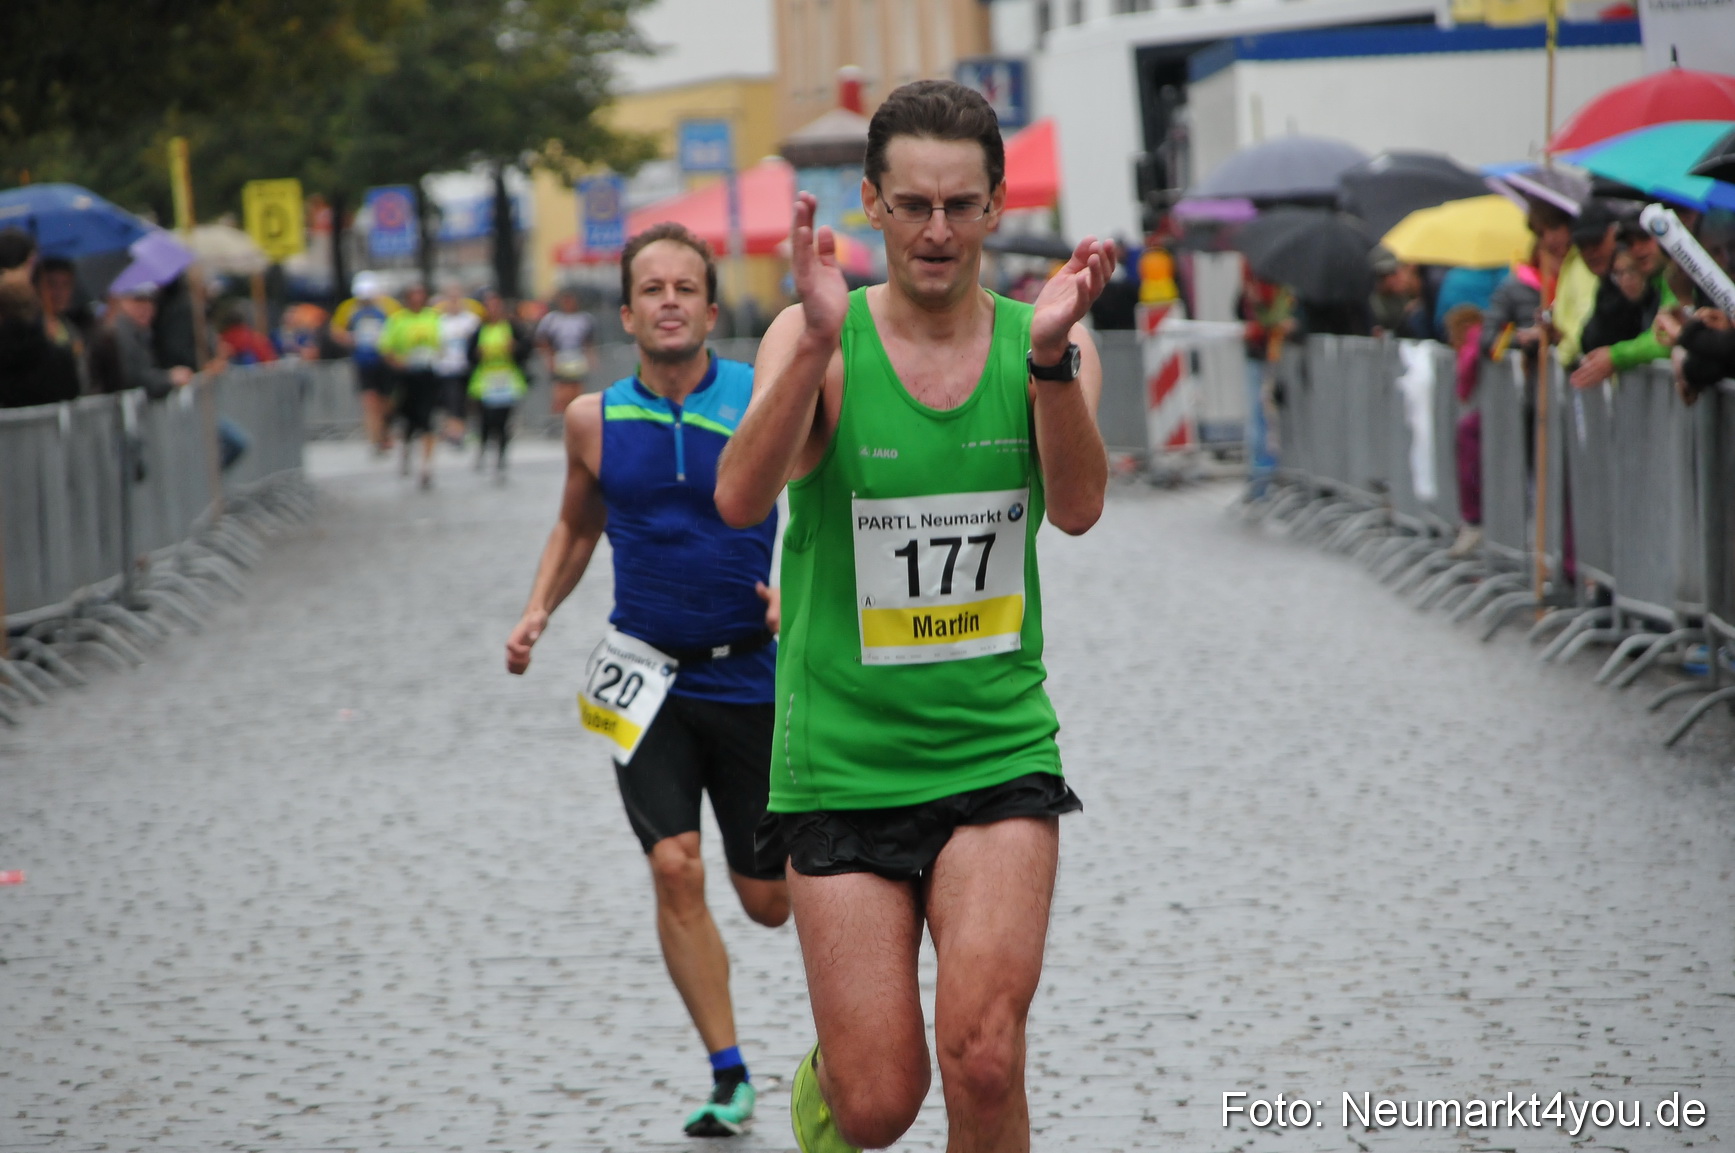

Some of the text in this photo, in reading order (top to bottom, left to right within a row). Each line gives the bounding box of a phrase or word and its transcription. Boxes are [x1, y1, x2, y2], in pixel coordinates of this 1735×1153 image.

[872, 447, 898, 459] JAKO
[857, 509, 1002, 532] PARTL Neumarkt
[894, 533, 997, 598] 177
[912, 611, 980, 639] Martin
